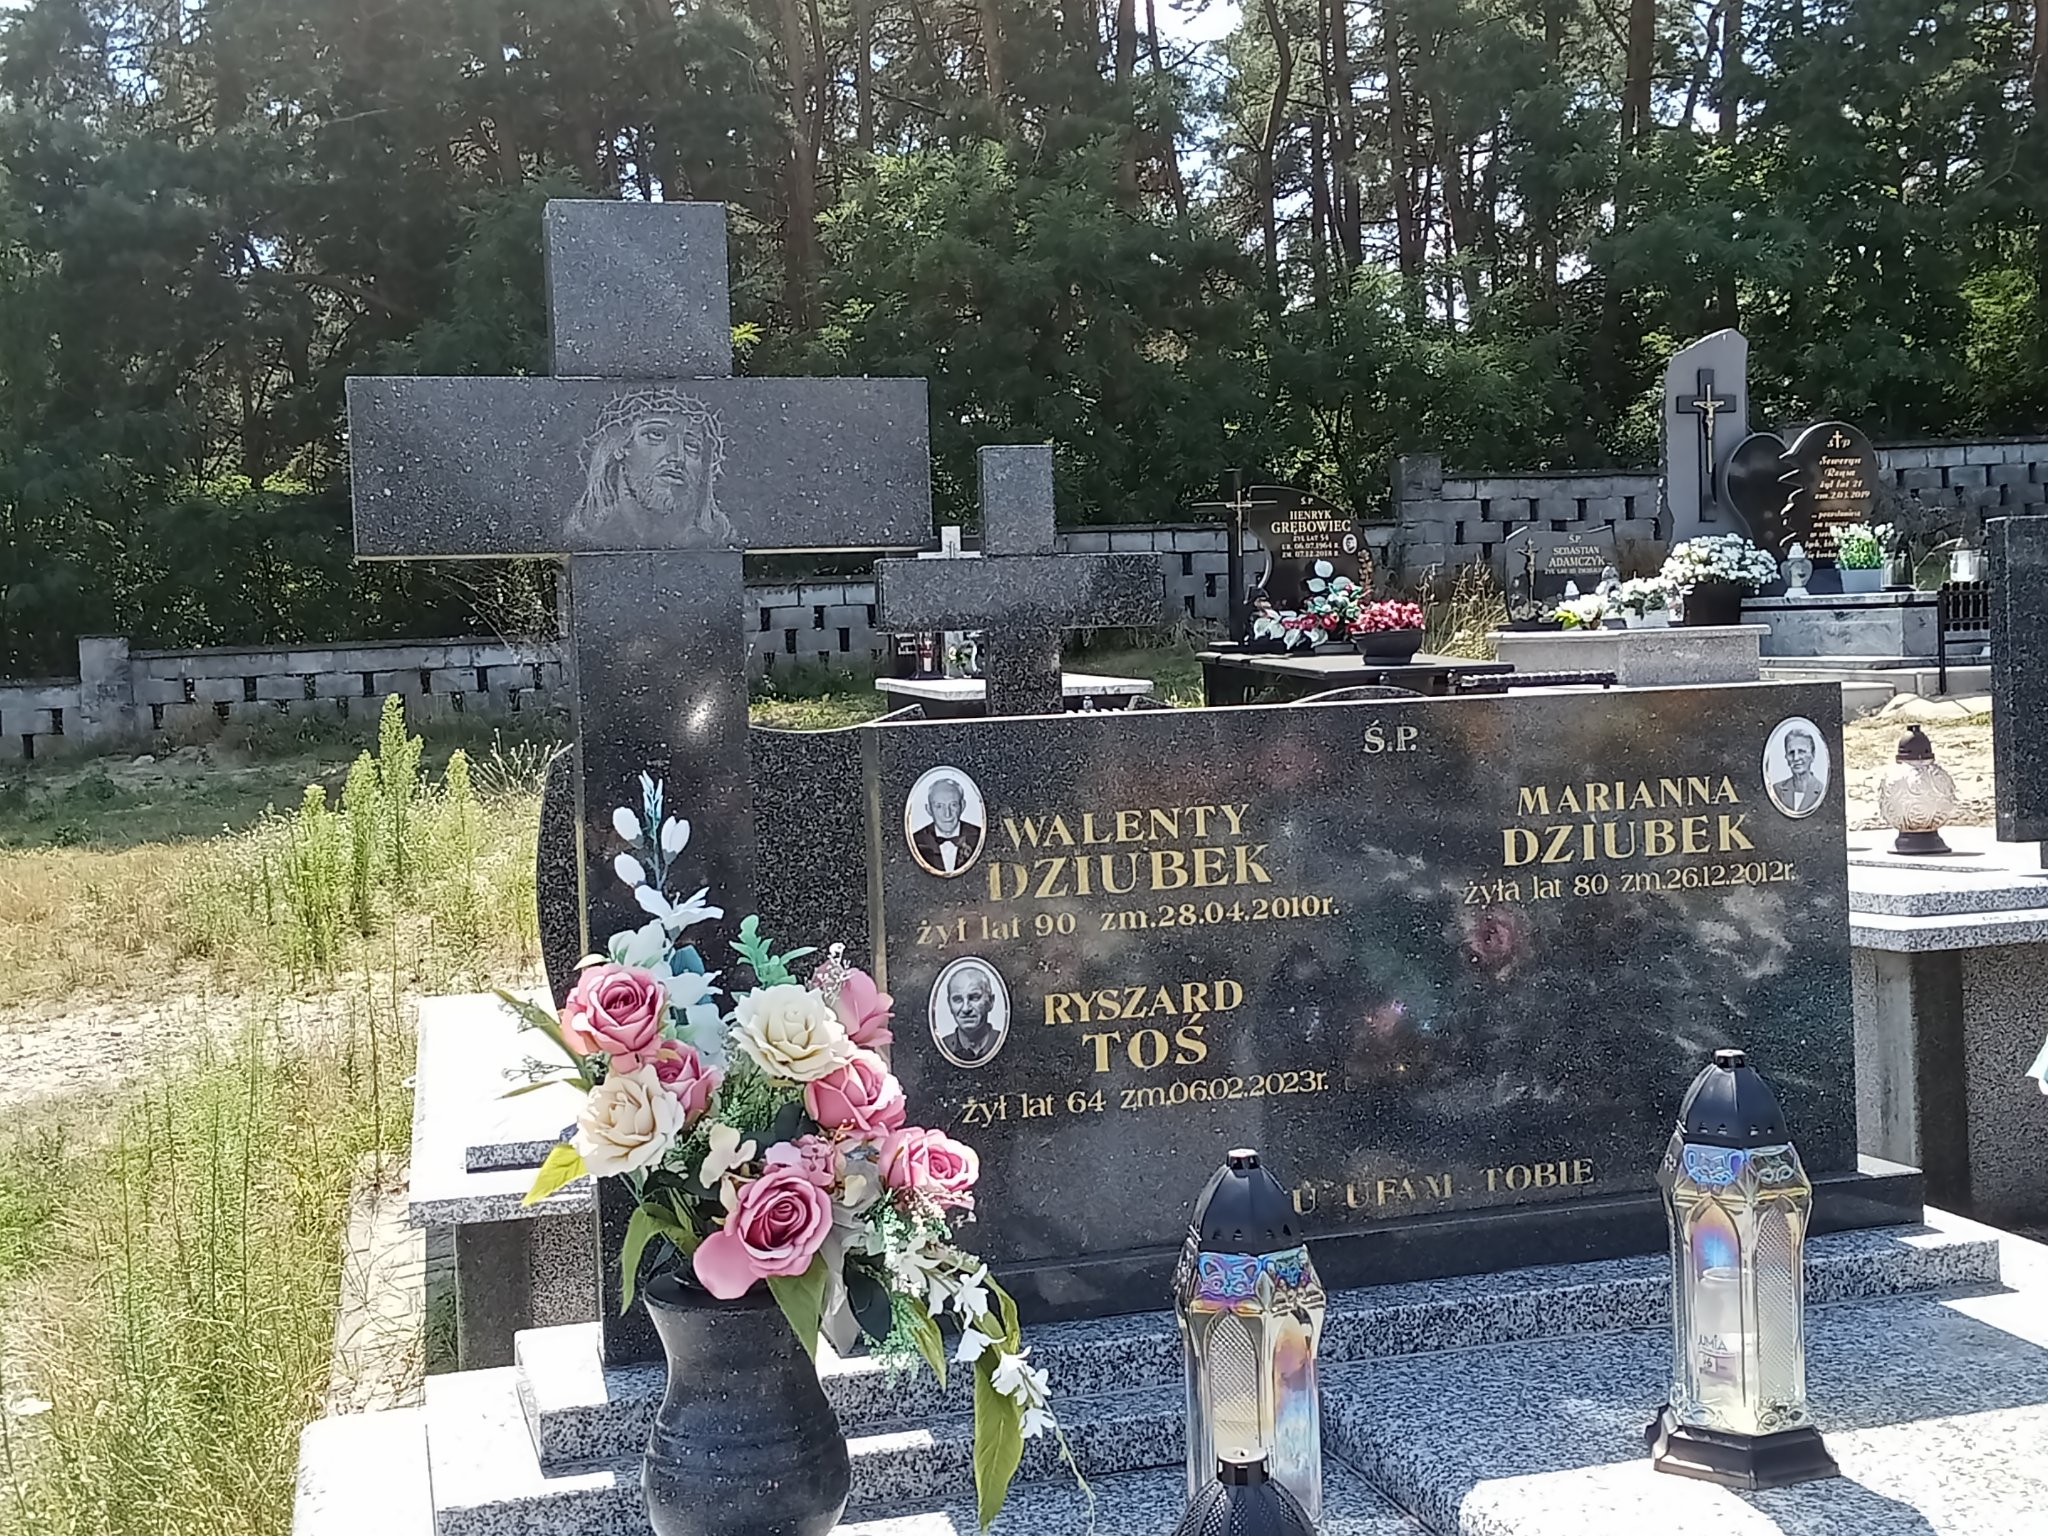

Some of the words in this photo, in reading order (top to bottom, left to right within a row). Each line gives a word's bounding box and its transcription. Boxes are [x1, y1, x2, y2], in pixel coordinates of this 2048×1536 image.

[1271, 520, 1351, 535] GRĘBOWIEC
[1290, 509, 1332, 521] HENRYK
[1548, 556, 1605, 568] ADAMCZYK
[1553, 546, 1600, 555] SEBASTIAN
[1516, 774, 1741, 817] MARIANNA
[1002, 803, 1250, 851] WALENTY
[1502, 813, 1756, 867] DZIUBEK
[986, 842, 1273, 903] DZIUBEK
[1464, 876, 1521, 907] żyła
[1532, 875, 1562, 900] lat
[1573, 873, 1609, 897] 80
[916, 917, 969, 950] żył
[981, 913, 1021, 941] lat
[1034, 911, 1077, 937] 90
[1043, 978, 1244, 1026] RYSZARD
[1081, 1013, 1209, 1074] TOŚ
[962, 1095, 1008, 1128] żył
[1021, 1092, 1055, 1119] lat
[1066, 1089, 1107, 1113] 64
[1345, 1172, 1455, 1210] UFAM
[1481, 1157, 1597, 1193] TOBIE
